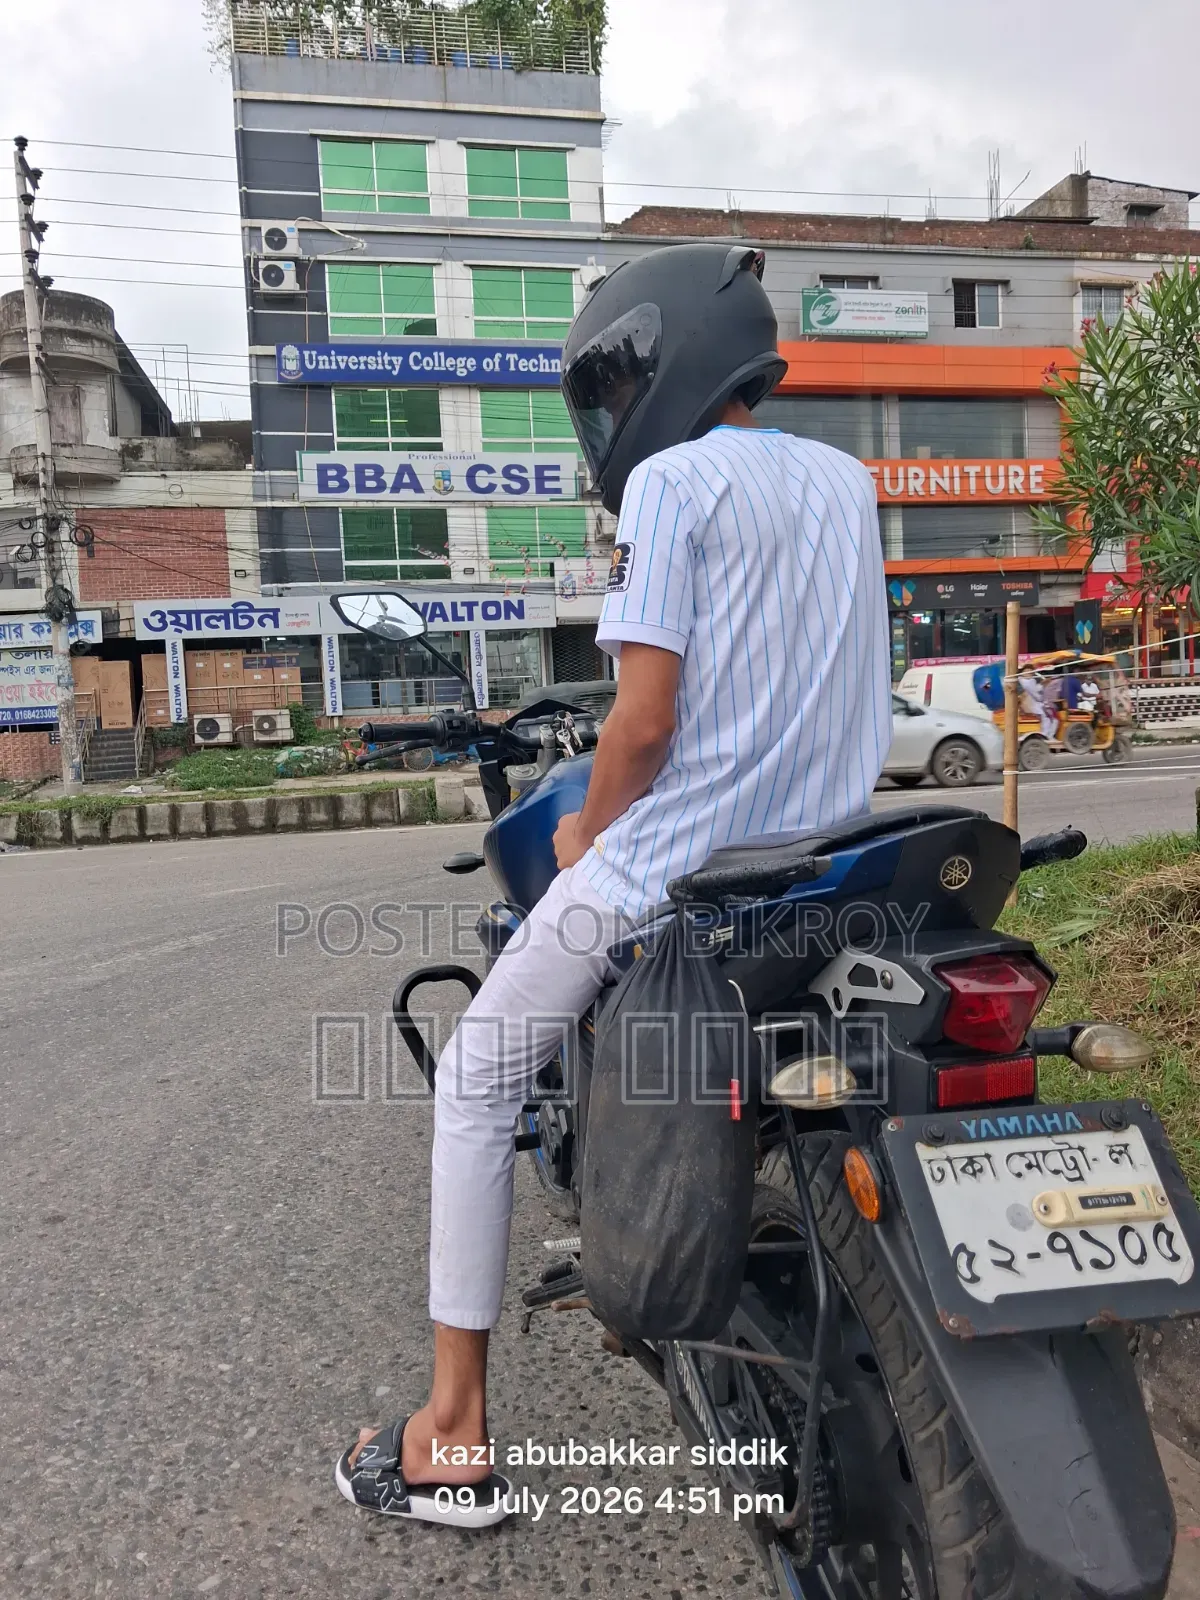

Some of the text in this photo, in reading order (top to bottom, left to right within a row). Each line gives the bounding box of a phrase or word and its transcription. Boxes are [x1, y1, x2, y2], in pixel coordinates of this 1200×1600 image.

[303, 350, 562, 376] University College of Techn
[408, 453, 477, 461] Professional
[316, 463, 563, 495] BBA CSE
[945, 582, 1034, 592] LG Haier TOSHIBA
[142, 601, 281, 634] ওয়ালটন
[171, 641, 183, 721] WALTON WALTON
[327, 636, 338, 713] WALTON WALTON
[960, 1111, 1084, 1140] YAMAHA
[922, 1152, 998, 1184] ঢাকা
[951, 1222, 1181, 1284] ৫২-৭১০৫
